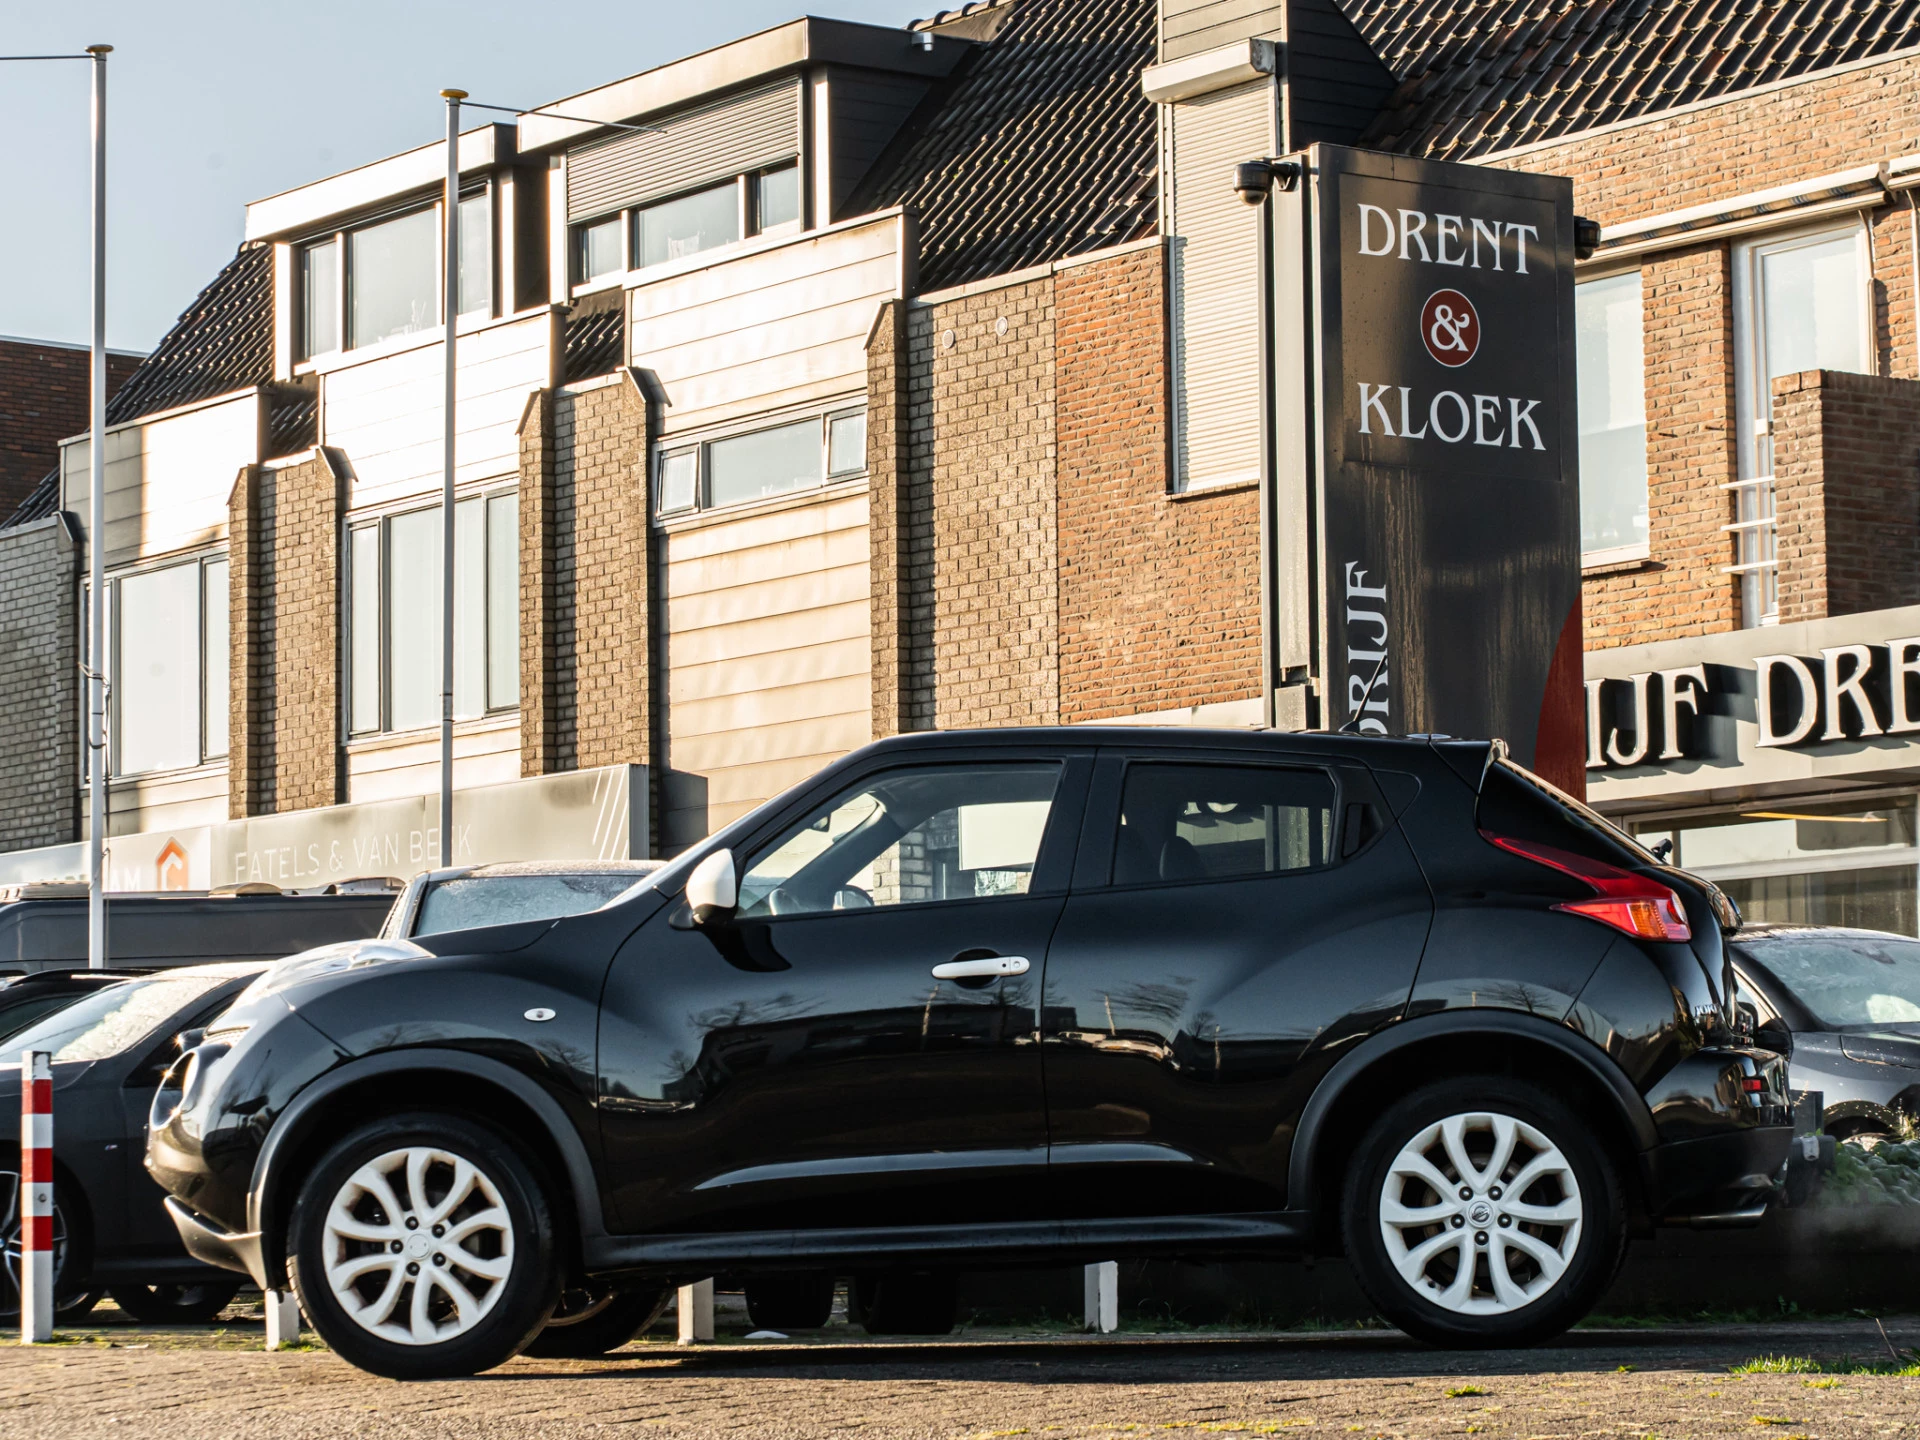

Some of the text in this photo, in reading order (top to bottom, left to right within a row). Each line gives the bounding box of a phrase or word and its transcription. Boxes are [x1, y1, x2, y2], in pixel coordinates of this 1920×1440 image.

[1357, 203, 1539, 275] DRENT
[1430, 304, 1470, 352] &
[1357, 382, 1547, 451] KLOEK
[329, 839, 345, 873] &
[353, 832, 399, 869] VAN
[410, 823, 472, 864] BEK
